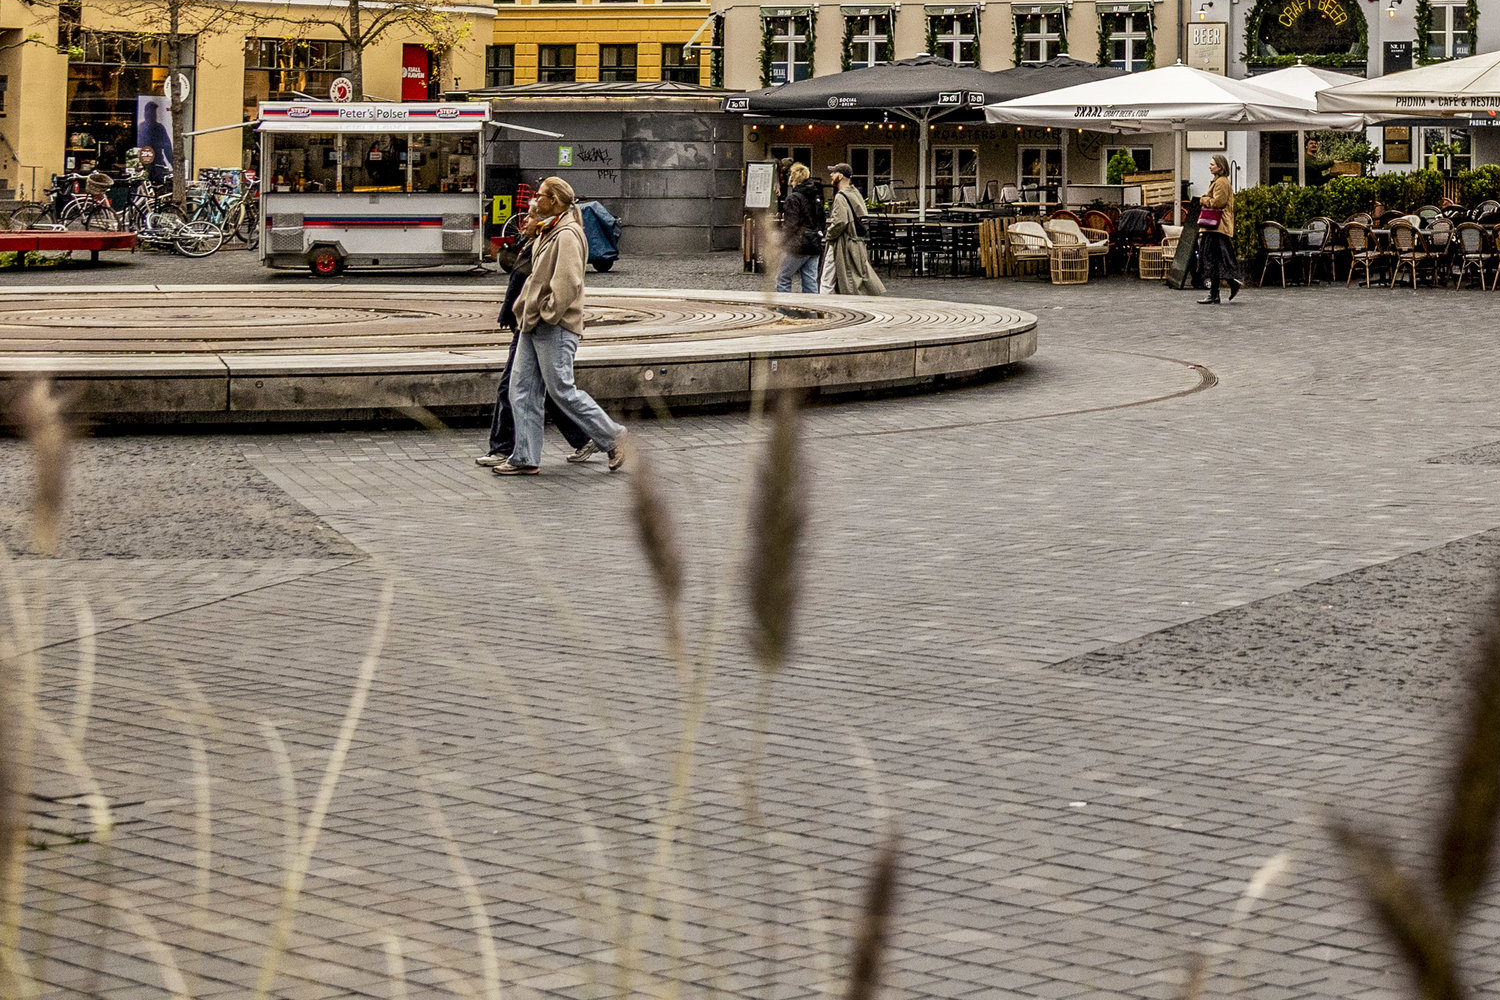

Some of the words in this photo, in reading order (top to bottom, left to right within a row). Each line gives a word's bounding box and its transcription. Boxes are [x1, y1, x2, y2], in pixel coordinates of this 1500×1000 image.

[1193, 28, 1220, 45] BEER
[1461, 98, 1467, 106] &
[339, 109, 373, 118] Peter's
[377, 108, 407, 118] Pølser
[1074, 106, 1102, 117] SKAAL
